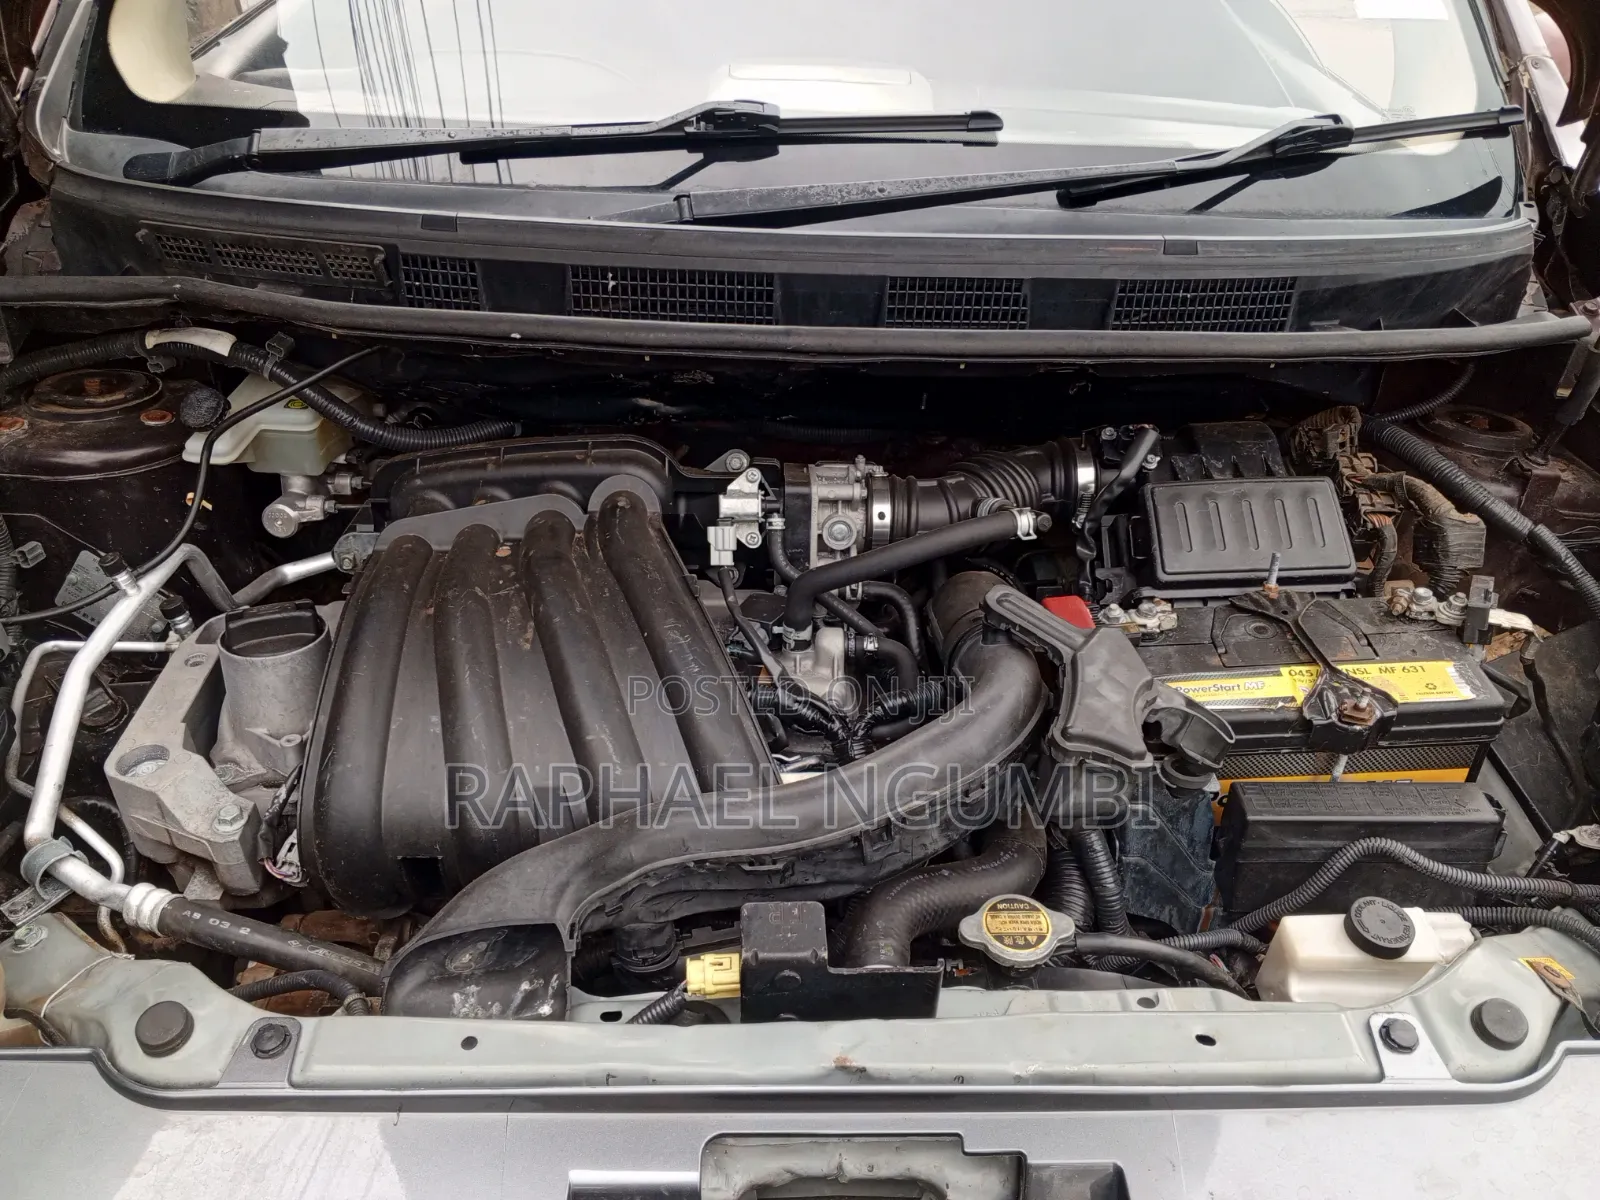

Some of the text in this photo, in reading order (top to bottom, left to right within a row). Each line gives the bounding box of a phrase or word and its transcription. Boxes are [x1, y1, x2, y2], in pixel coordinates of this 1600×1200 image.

[1378, 665, 1397, 674] MF
[1402, 664, 1426, 673] 631
[1175, 680, 1265, 694] PowerStart MF
[239, 927, 250, 935] 2
